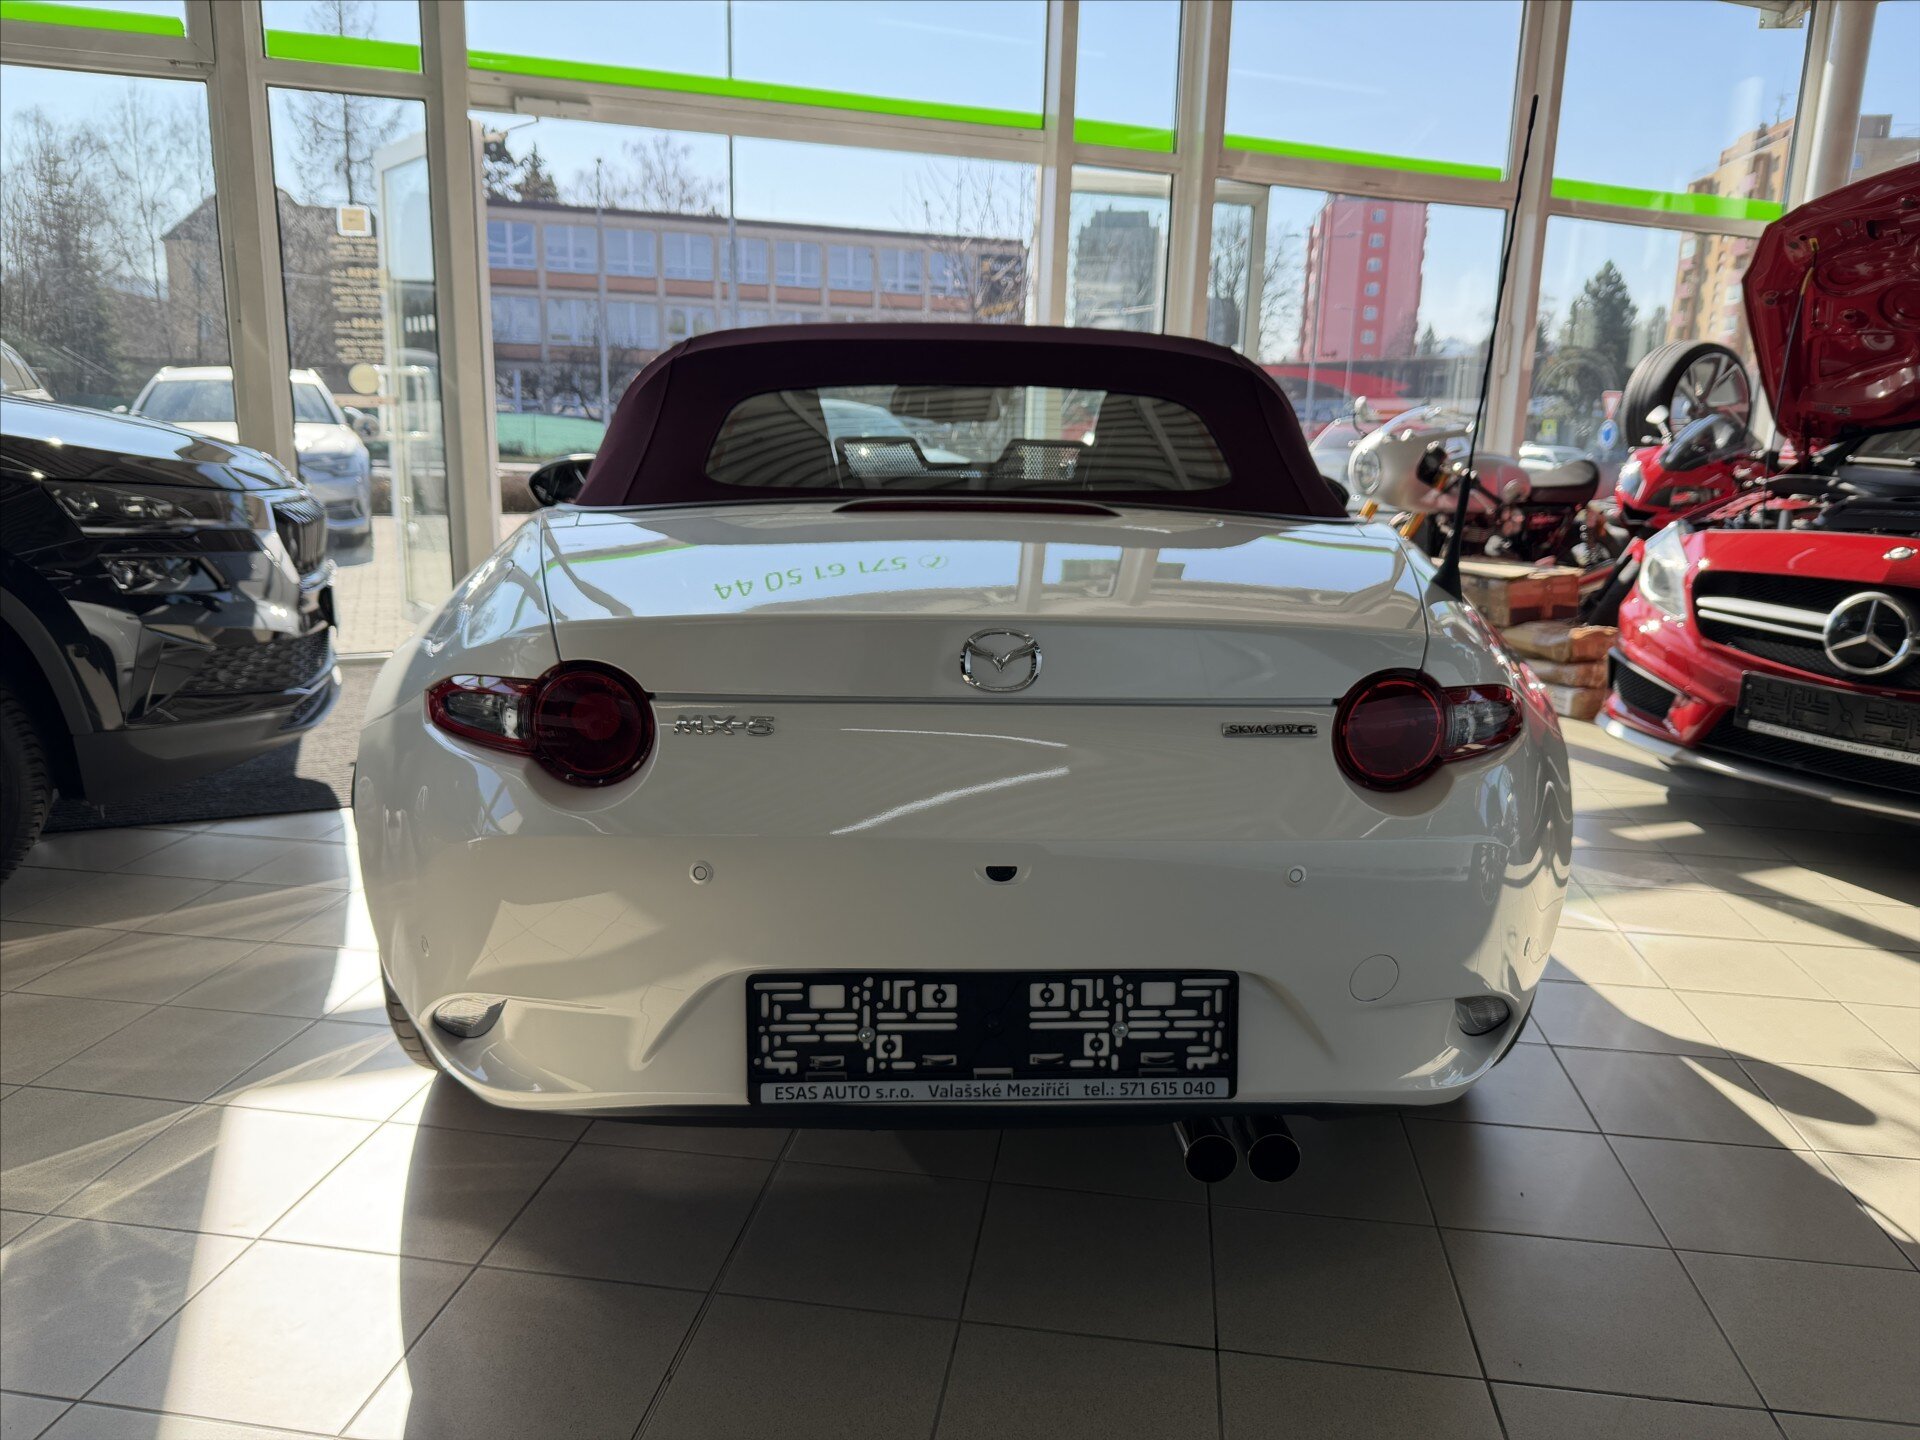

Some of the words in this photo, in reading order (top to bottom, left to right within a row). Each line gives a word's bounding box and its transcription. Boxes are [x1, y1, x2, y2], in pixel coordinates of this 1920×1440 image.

[814, 562, 846, 580] 61
[858, 556, 907, 574] 571
[713, 579, 753, 600] 44
[764, 567, 803, 592] 50
[674, 715, 775, 737] MX-5
[774, 1086, 818, 1100] ESAS
[822, 1085, 871, 1100] AUTO
[875, 1086, 915, 1099] s.r.o.
[928, 1083, 1002, 1098] Valašské
[1007, 1082, 1070, 1097] Meziříčí
[1083, 1082, 1115, 1096] tel.:
[1119, 1082, 1145, 1096] 571
[1151, 1081, 1178, 1095] 615
[1183, 1081, 1216, 1095] 040
